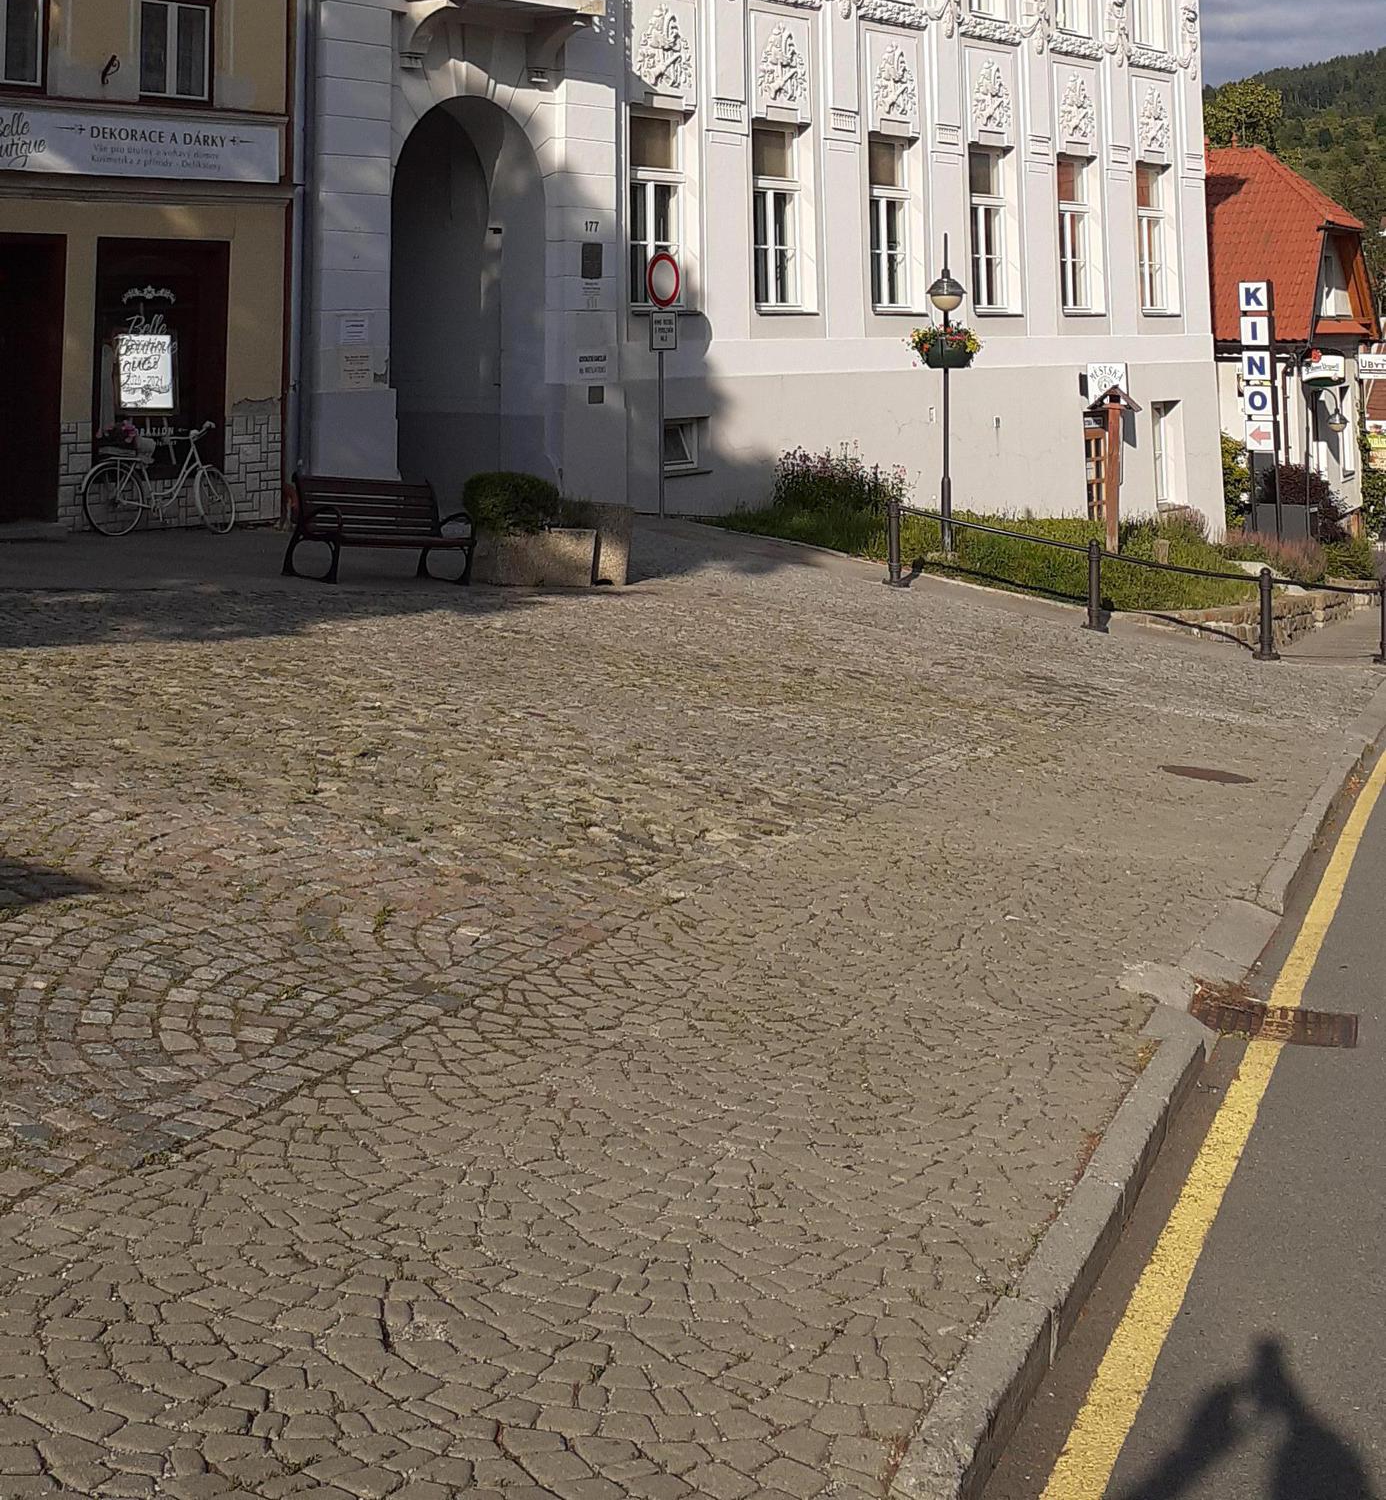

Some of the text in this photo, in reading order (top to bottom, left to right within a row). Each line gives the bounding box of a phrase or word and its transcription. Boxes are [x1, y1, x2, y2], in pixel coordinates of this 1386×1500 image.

[0, 112, 30, 137] elle
[90, 126, 226, 148] DEKORACE A DÁRKY
[0, 137, 46, 168] utique
[584, 220, 600, 233] 177
[126, 314, 168, 336] Belle
[1244, 286, 1269, 412] KINO
